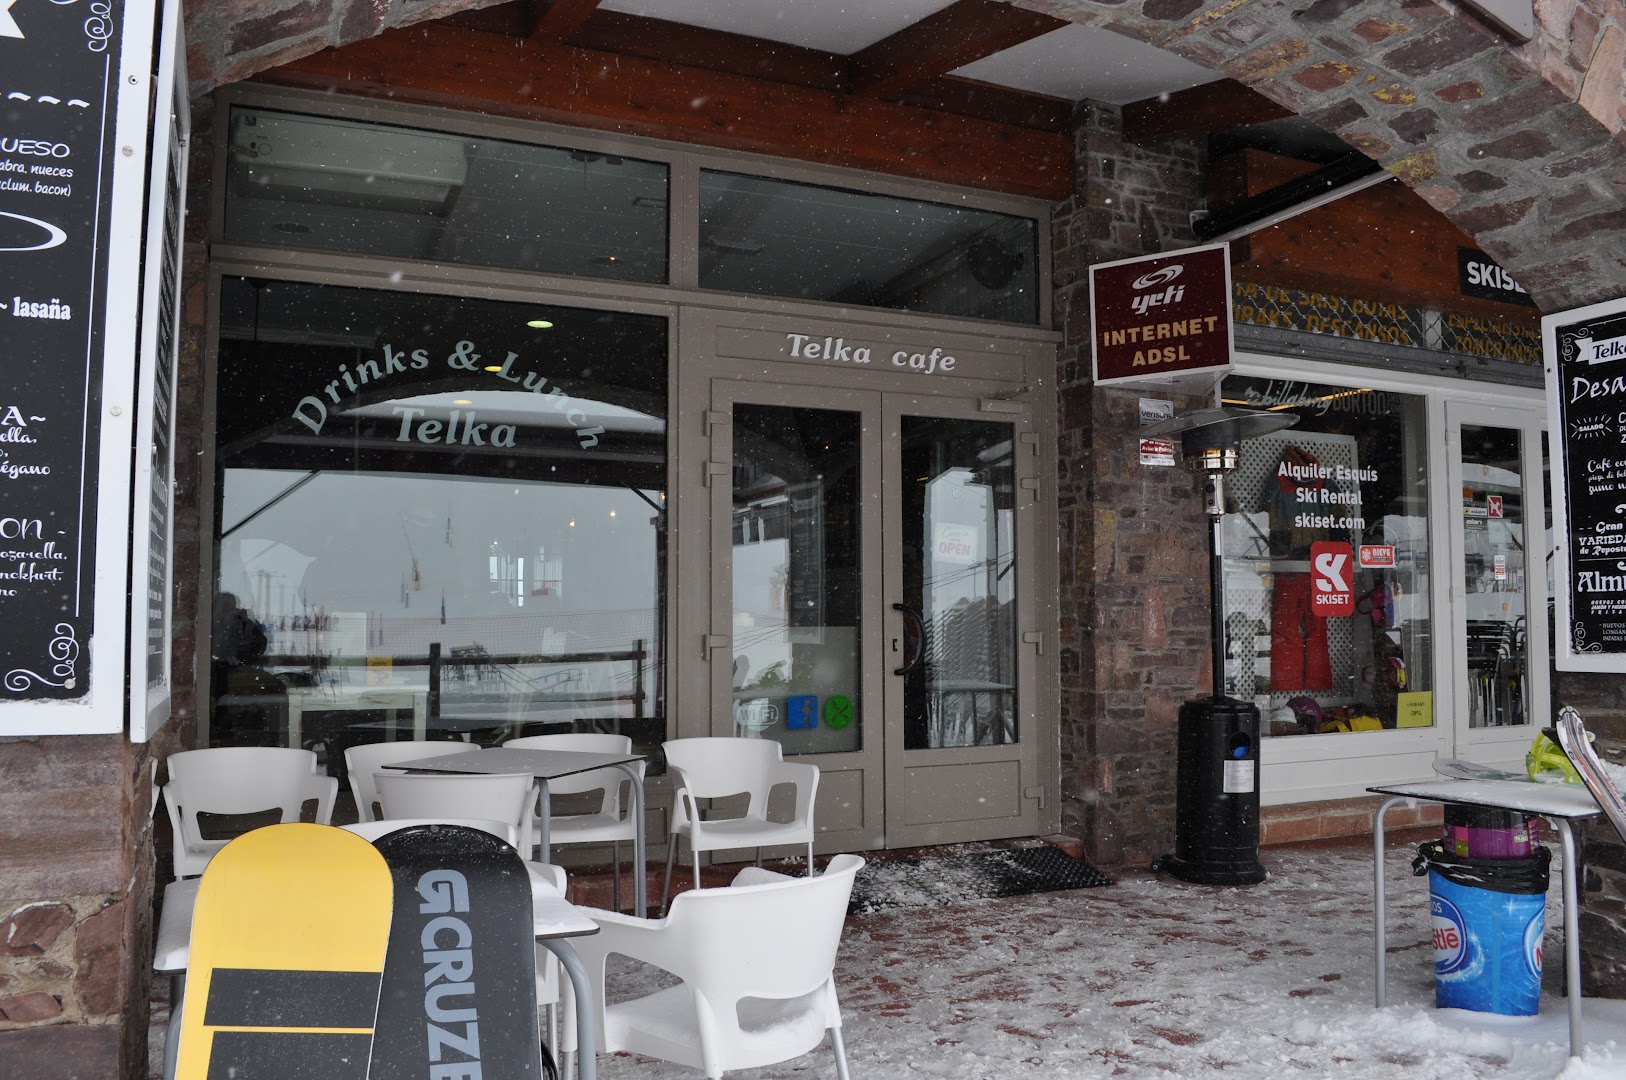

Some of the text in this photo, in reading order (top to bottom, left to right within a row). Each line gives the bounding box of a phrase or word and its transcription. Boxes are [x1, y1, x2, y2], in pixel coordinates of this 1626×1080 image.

[31, 165, 74, 178] nueces
[34, 181, 72, 197] bacon)
[12, 296, 71, 320] lasaña
[1131, 284, 1186, 315] yeti
[1103, 315, 1218, 347] INTERNET
[786, 333, 956, 375] Telka cafe
[1132, 345, 1190, 367] ADSL
[1592, 341, 1626, 360] Telk
[291, 340, 605, 450] Drinks & Lunch
[392, 406, 516, 448] Telka
[1578, 423, 1604, 433] SALADO
[0, 460, 51, 479] égano
[1278, 461, 1378, 485] Alquiler Esquís
[1587, 457, 1612, 473] Café
[1296, 486, 1363, 506] Ski Rental
[1294, 512, 1366, 530] skiset.com
[1595, 521, 1624, 534] Gran
[938, 542, 971, 557] OPEN
[1579, 546, 1590, 555] de
[1316, 594, 1350, 605] SKISET
